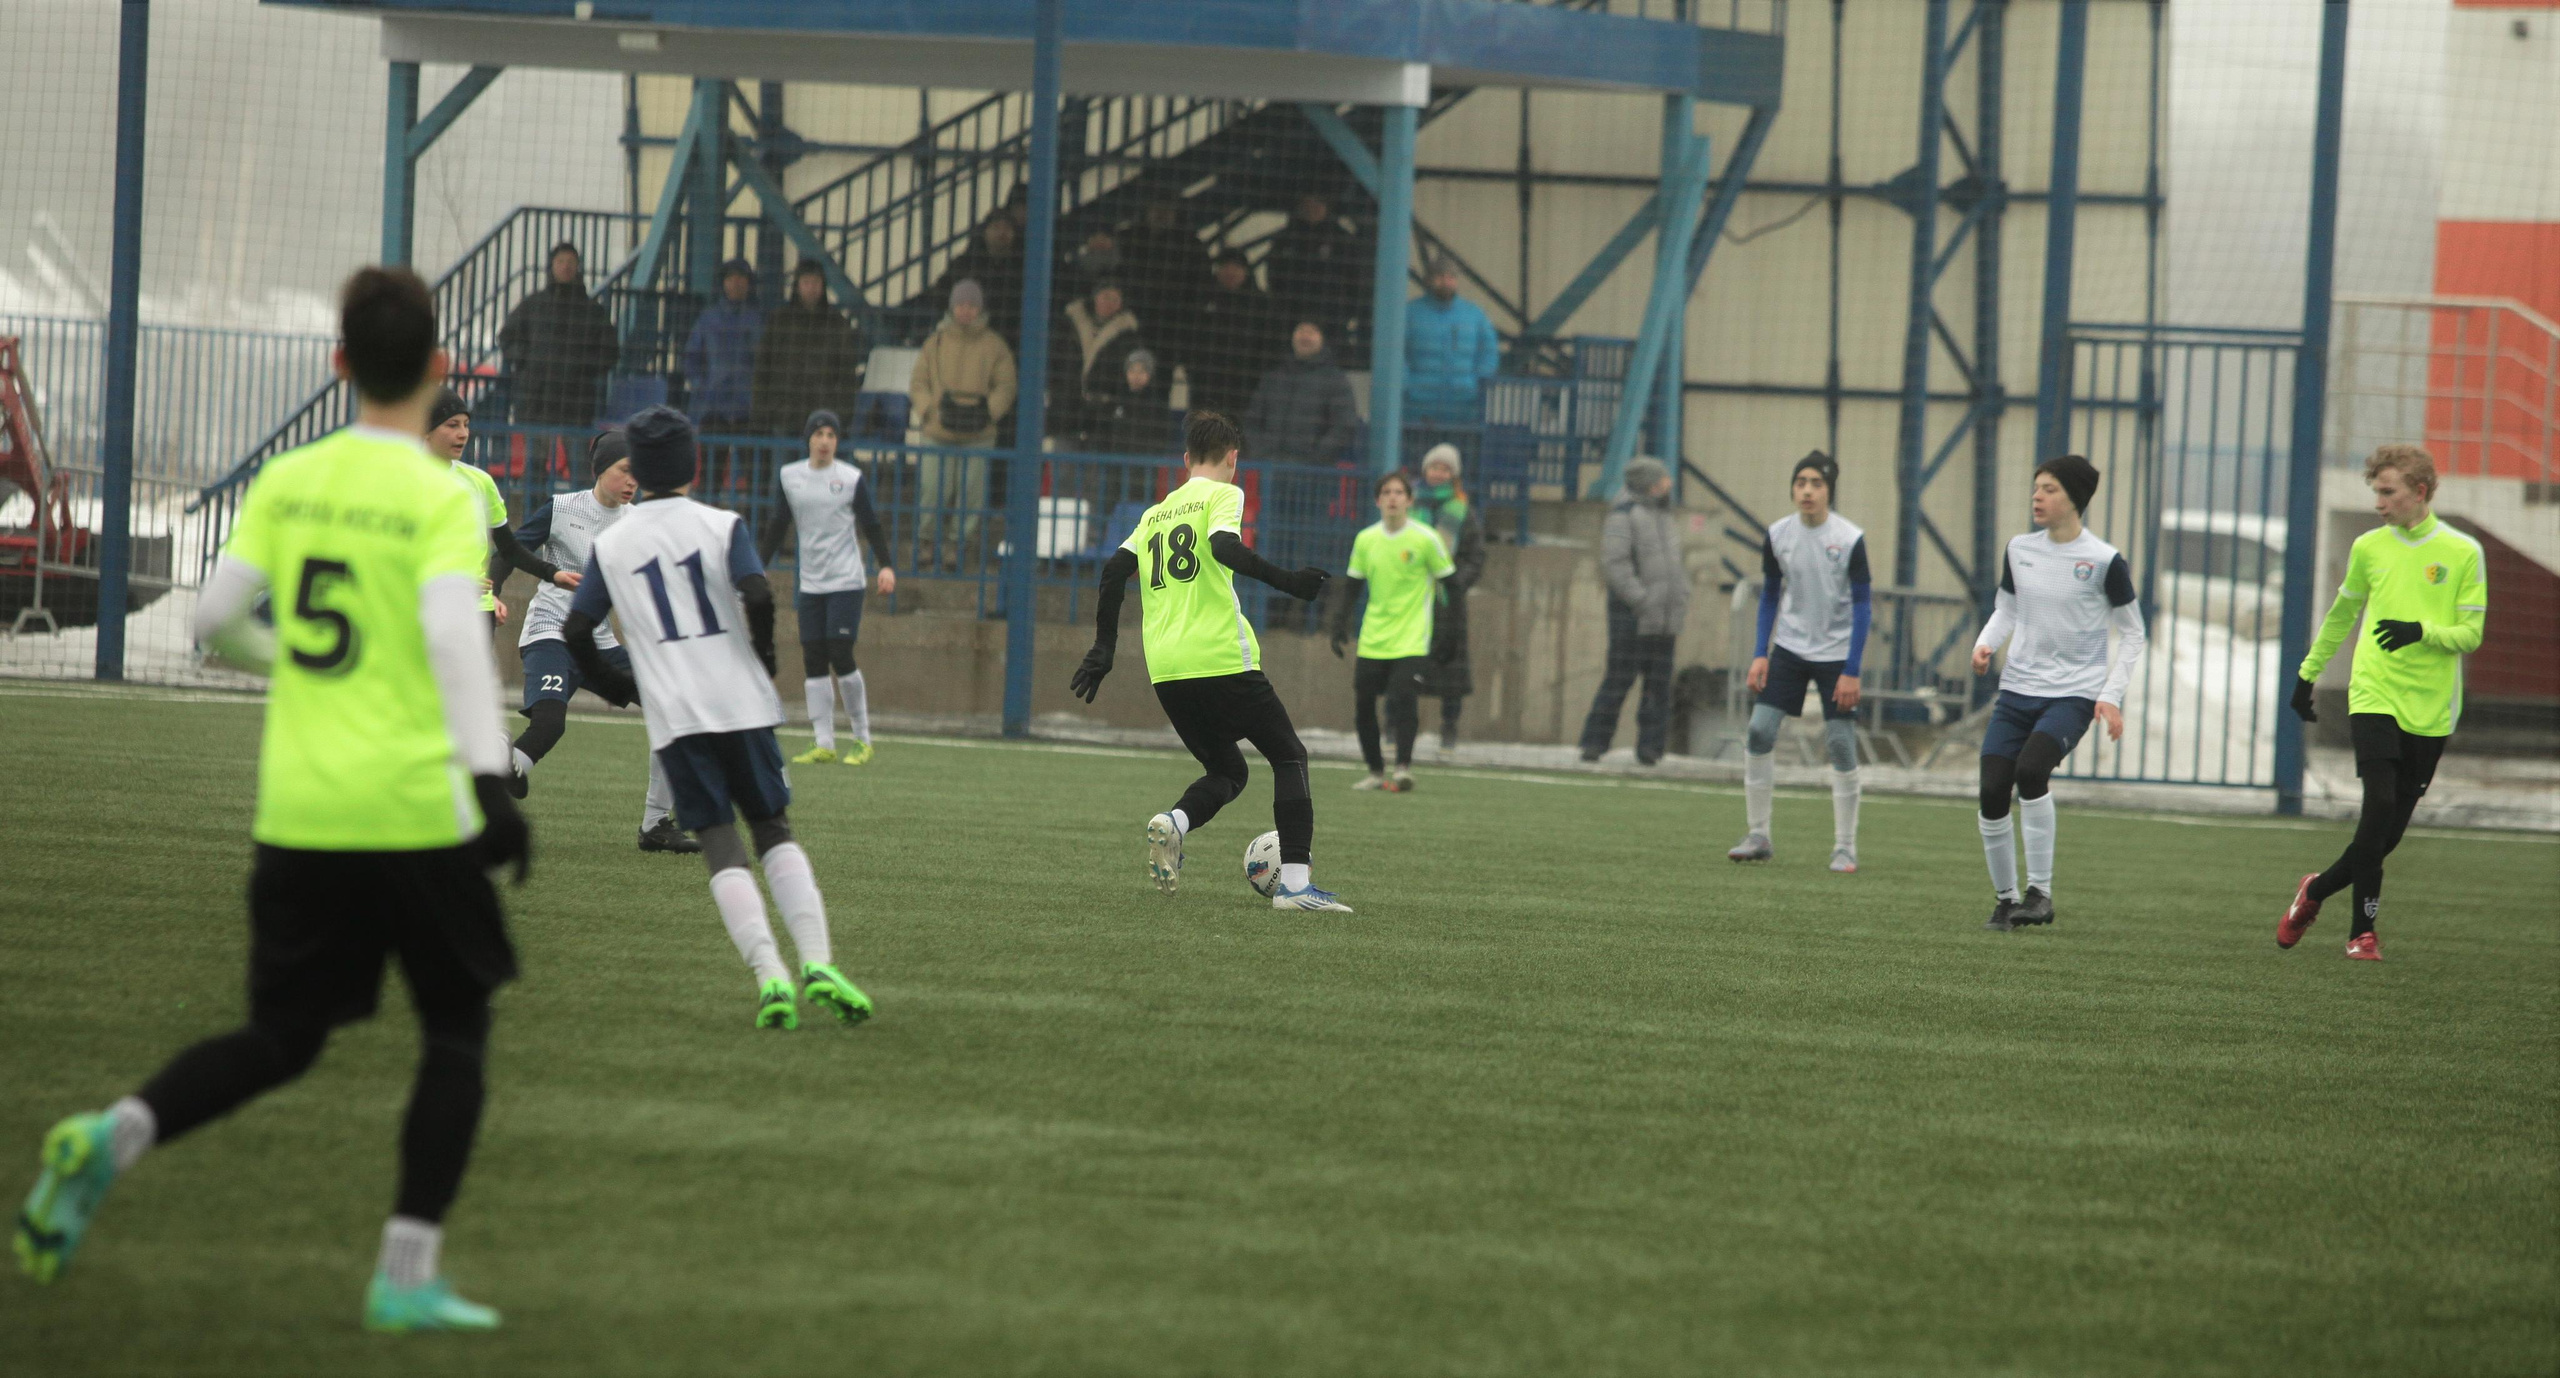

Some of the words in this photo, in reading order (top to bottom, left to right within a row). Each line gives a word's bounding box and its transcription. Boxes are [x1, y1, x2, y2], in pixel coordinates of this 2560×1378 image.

[1147, 509, 1173, 527] СЕНА
[1147, 523, 1201, 591] 18
[290, 557, 363, 680] 5
[631, 548, 728, 644] 11
[540, 674, 563, 692] 22
[1264, 867, 1282, 893] VECTOR
